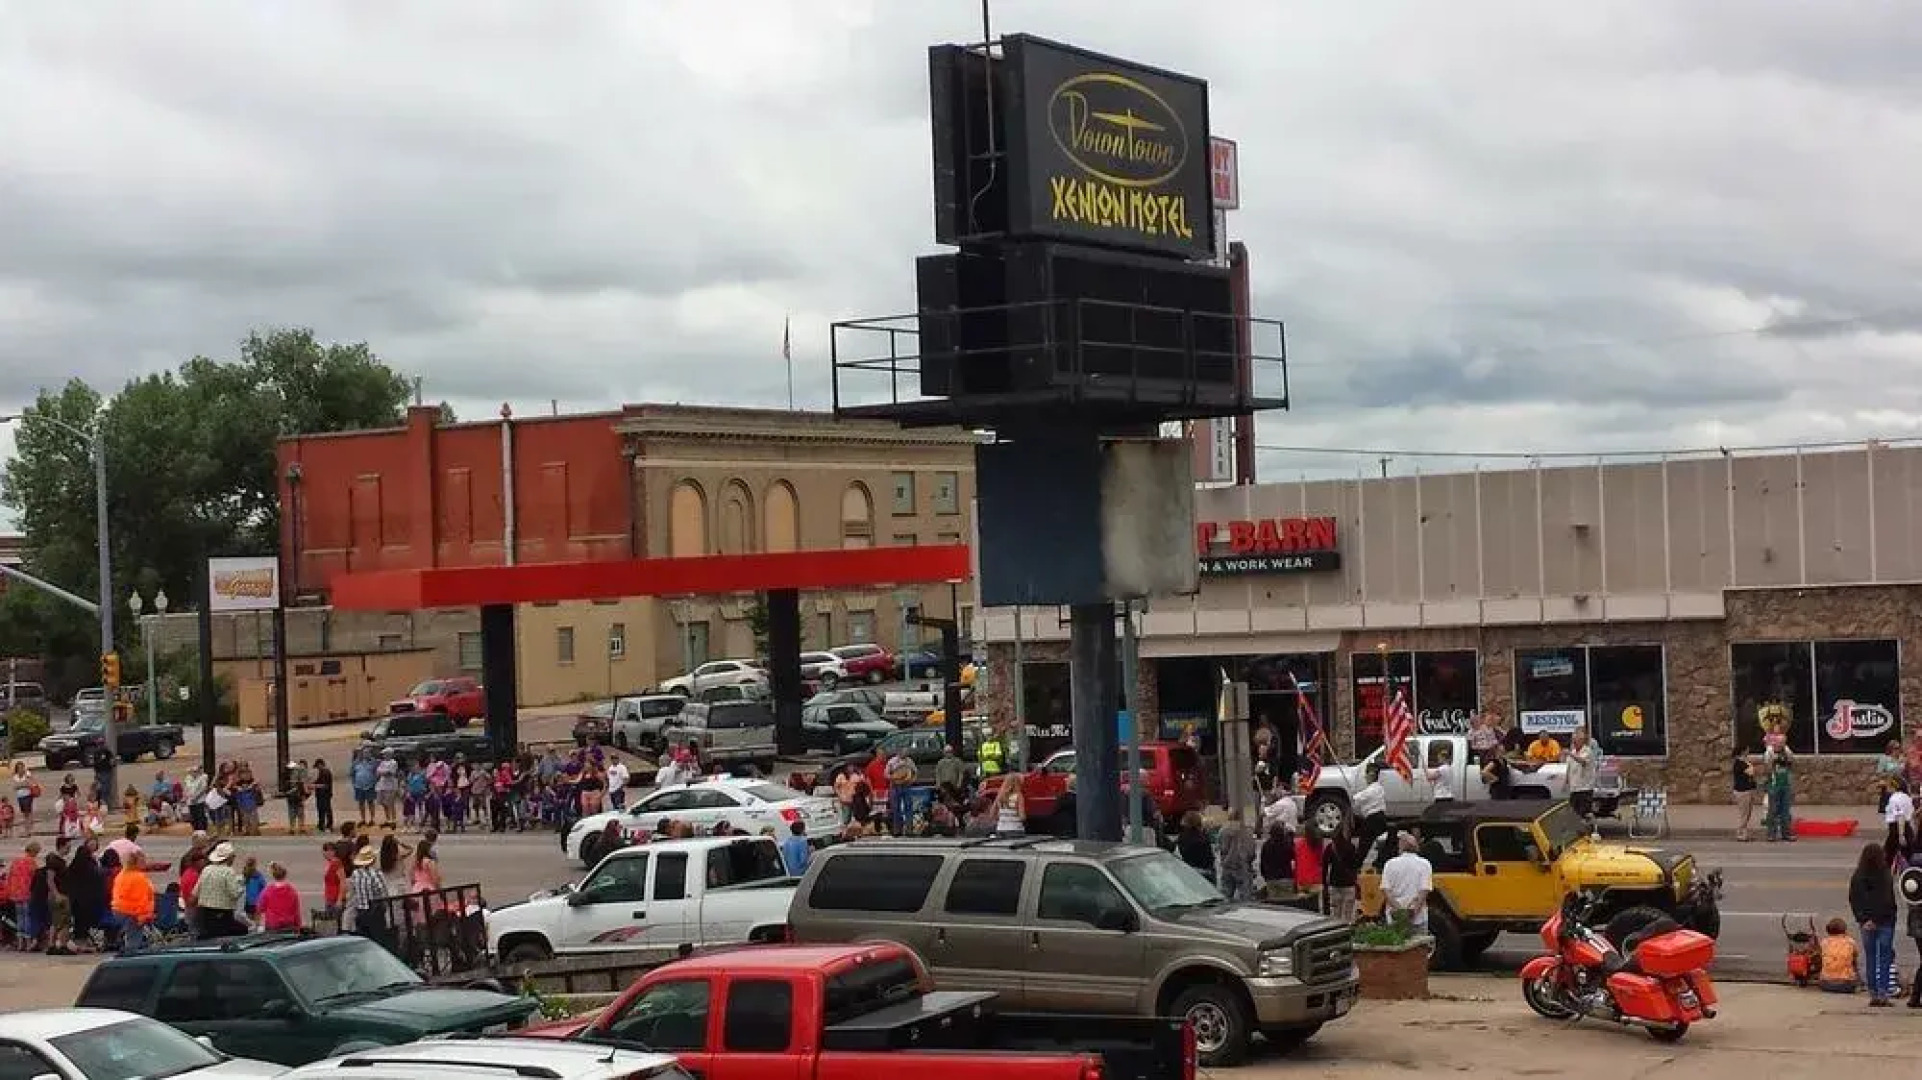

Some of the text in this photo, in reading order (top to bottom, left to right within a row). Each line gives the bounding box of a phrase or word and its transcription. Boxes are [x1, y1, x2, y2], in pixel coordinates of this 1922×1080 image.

[1051, 176, 1193, 239] XENION MOTEL
[1229, 517, 1337, 553] BARN
[1212, 561, 1224, 571] &
[1225, 559, 1268, 570] WORK
[1272, 557, 1313, 568] WEAR
[1525, 713, 1579, 726] RESISTOL
[1831, 704, 1887, 736] Justin
